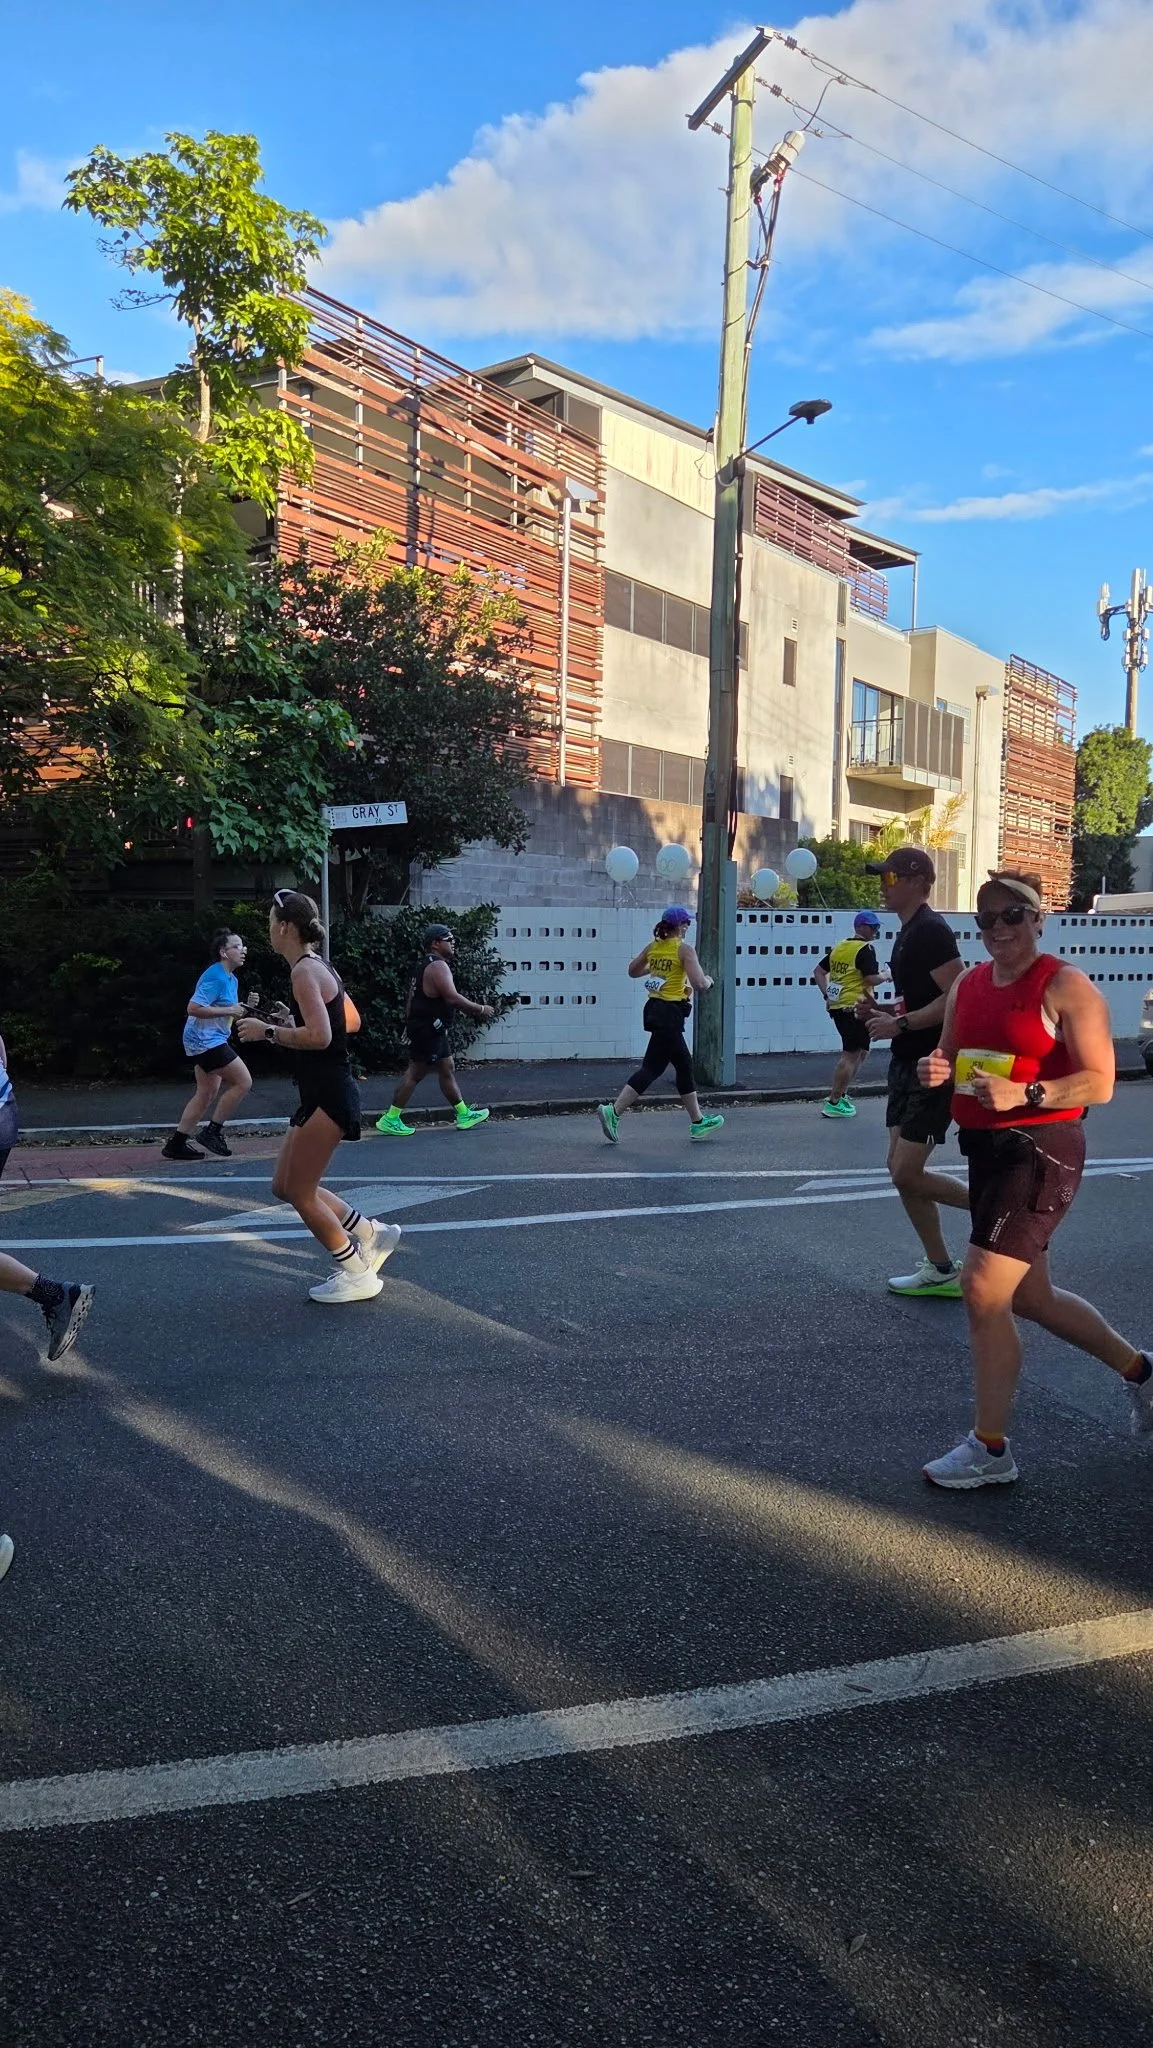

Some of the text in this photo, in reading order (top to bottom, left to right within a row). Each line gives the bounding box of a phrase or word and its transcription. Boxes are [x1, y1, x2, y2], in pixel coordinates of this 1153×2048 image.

[352, 804, 398, 819] GRAY ST
[649, 958, 673, 972] PACER
[826, 985, 840, 996] 6:00
